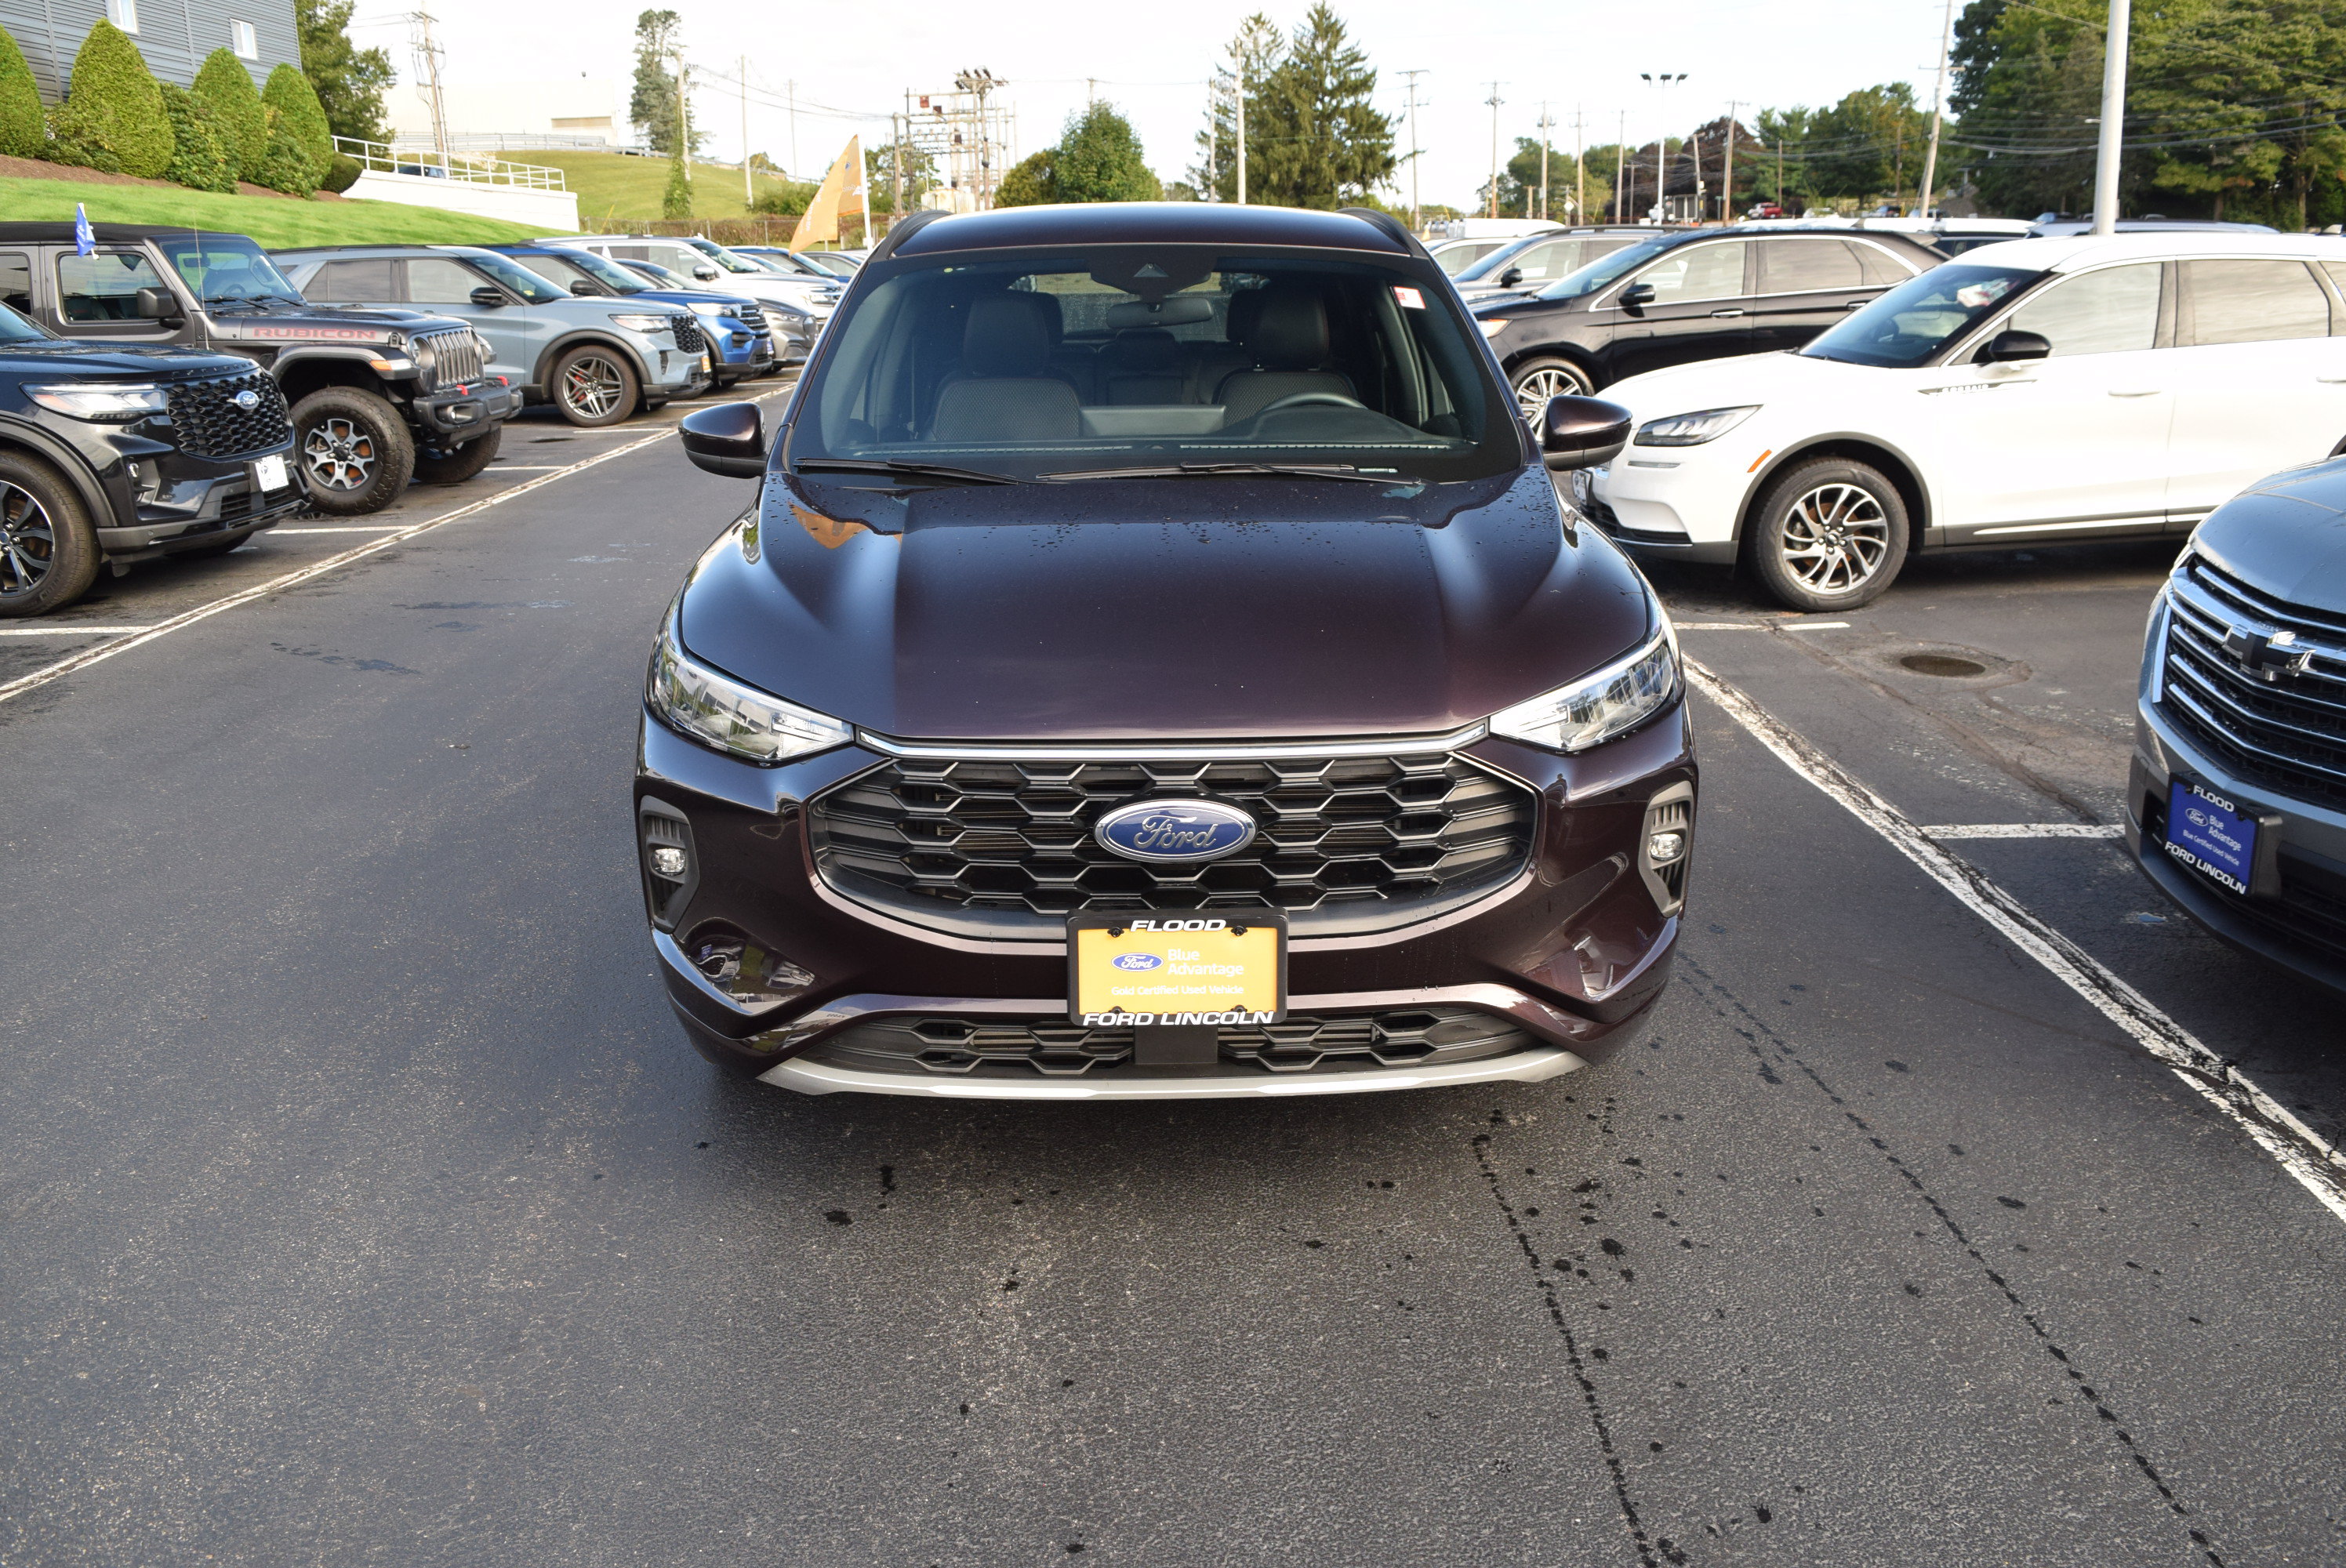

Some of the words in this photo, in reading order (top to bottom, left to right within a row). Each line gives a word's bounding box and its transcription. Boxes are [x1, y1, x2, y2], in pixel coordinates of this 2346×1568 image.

[253, 327, 376, 339] RUBICON
[2193, 785, 2235, 812] FLOOD
[2189, 810, 2205, 824] Ford
[2210, 815, 2224, 830] Blue
[1133, 815, 1218, 848] Ford
[2208, 826, 2242, 851] Advantage
[2164, 841, 2195, 865] FORD
[2196, 858, 2246, 895] LINCOLN
[1130, 920, 1226, 932] FLOOD
[1120, 955, 1153, 969] Ford
[1168, 949, 1200, 961] Blue
[1167, 963, 1244, 978] Advantage
[1111, 985, 1135, 996] Gold
[1137, 985, 1178, 996] Certified
[1182, 985, 1207, 995] Used
[1208, 985, 1244, 994] Vehicle
[1083, 1012, 1153, 1026] FORD
[1160, 1011, 1274, 1025] LINCOLN
